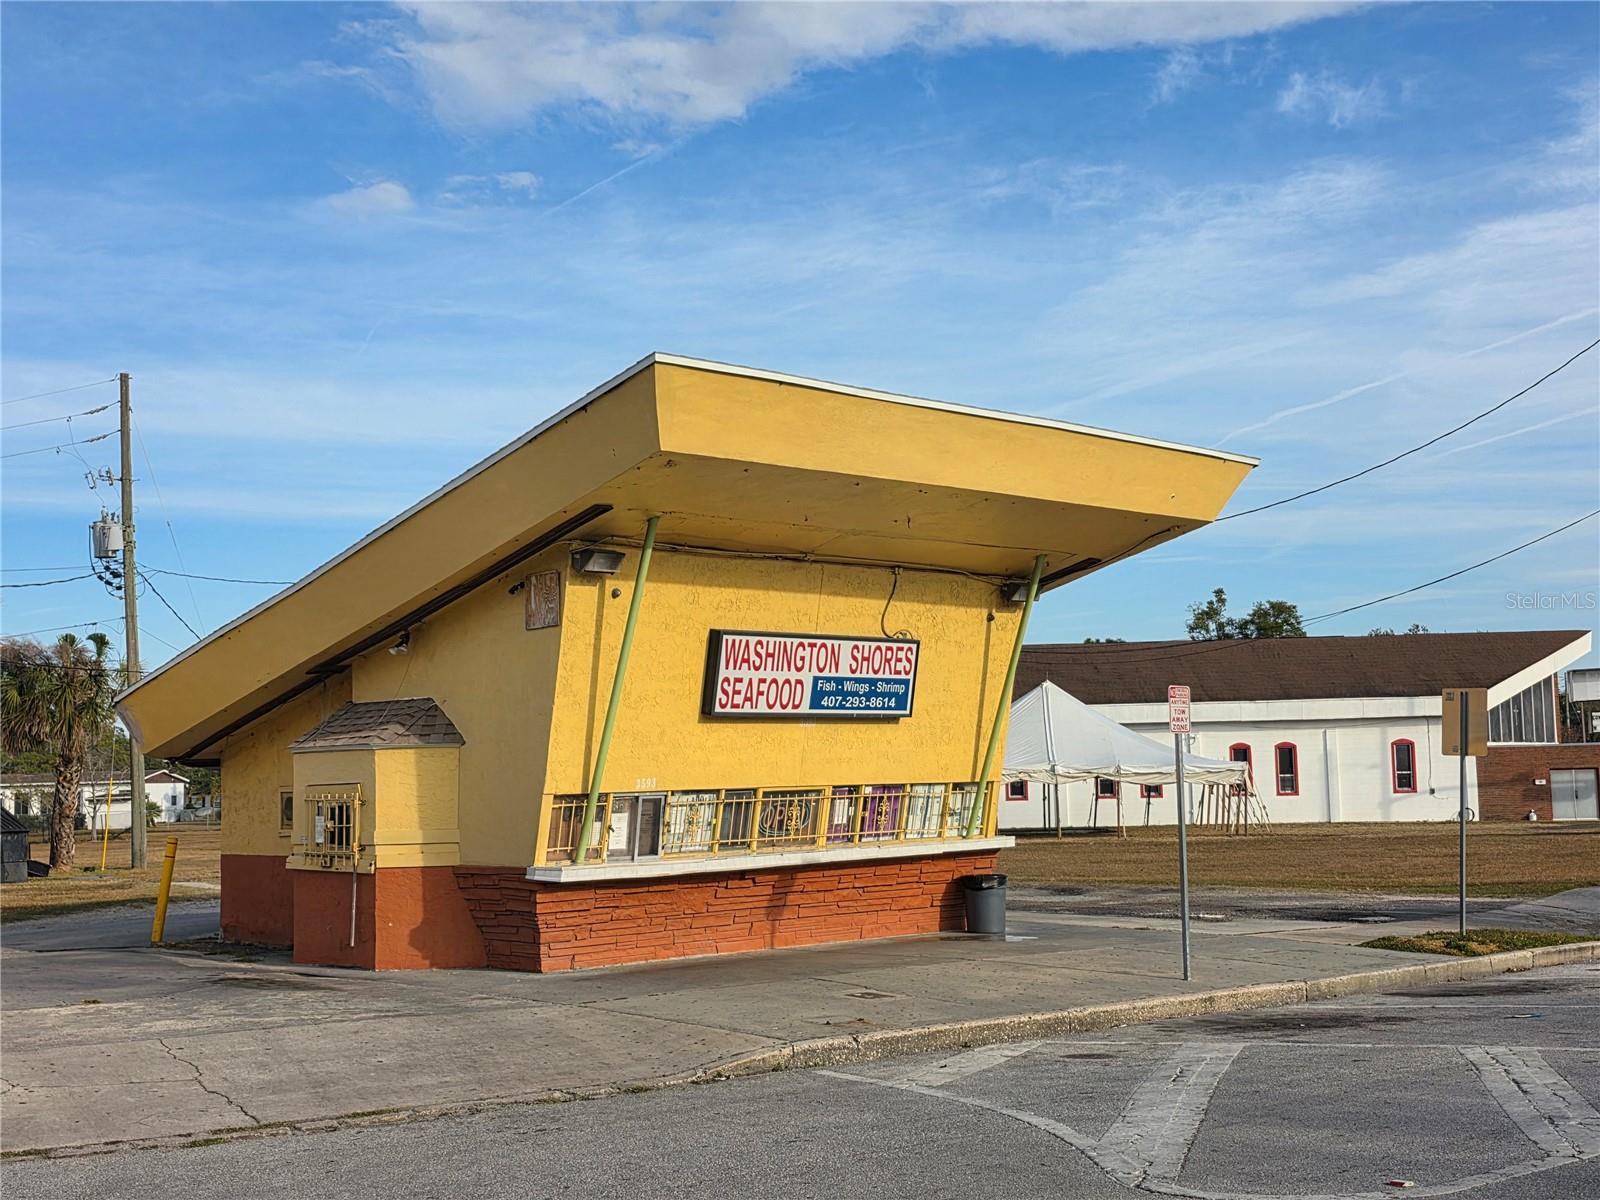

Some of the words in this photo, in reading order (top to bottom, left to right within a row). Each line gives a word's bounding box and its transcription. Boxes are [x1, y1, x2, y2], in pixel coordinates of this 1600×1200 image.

[724, 638, 842, 674] WASHINGTON
[849, 643, 914, 676] SHORES
[718, 676, 805, 710] SEAFOOD
[817, 680, 836, 692] Fish
[843, 681, 870, 694] Wings
[876, 681, 905, 695] Shrimp
[821, 696, 896, 708] 407-293-8614
